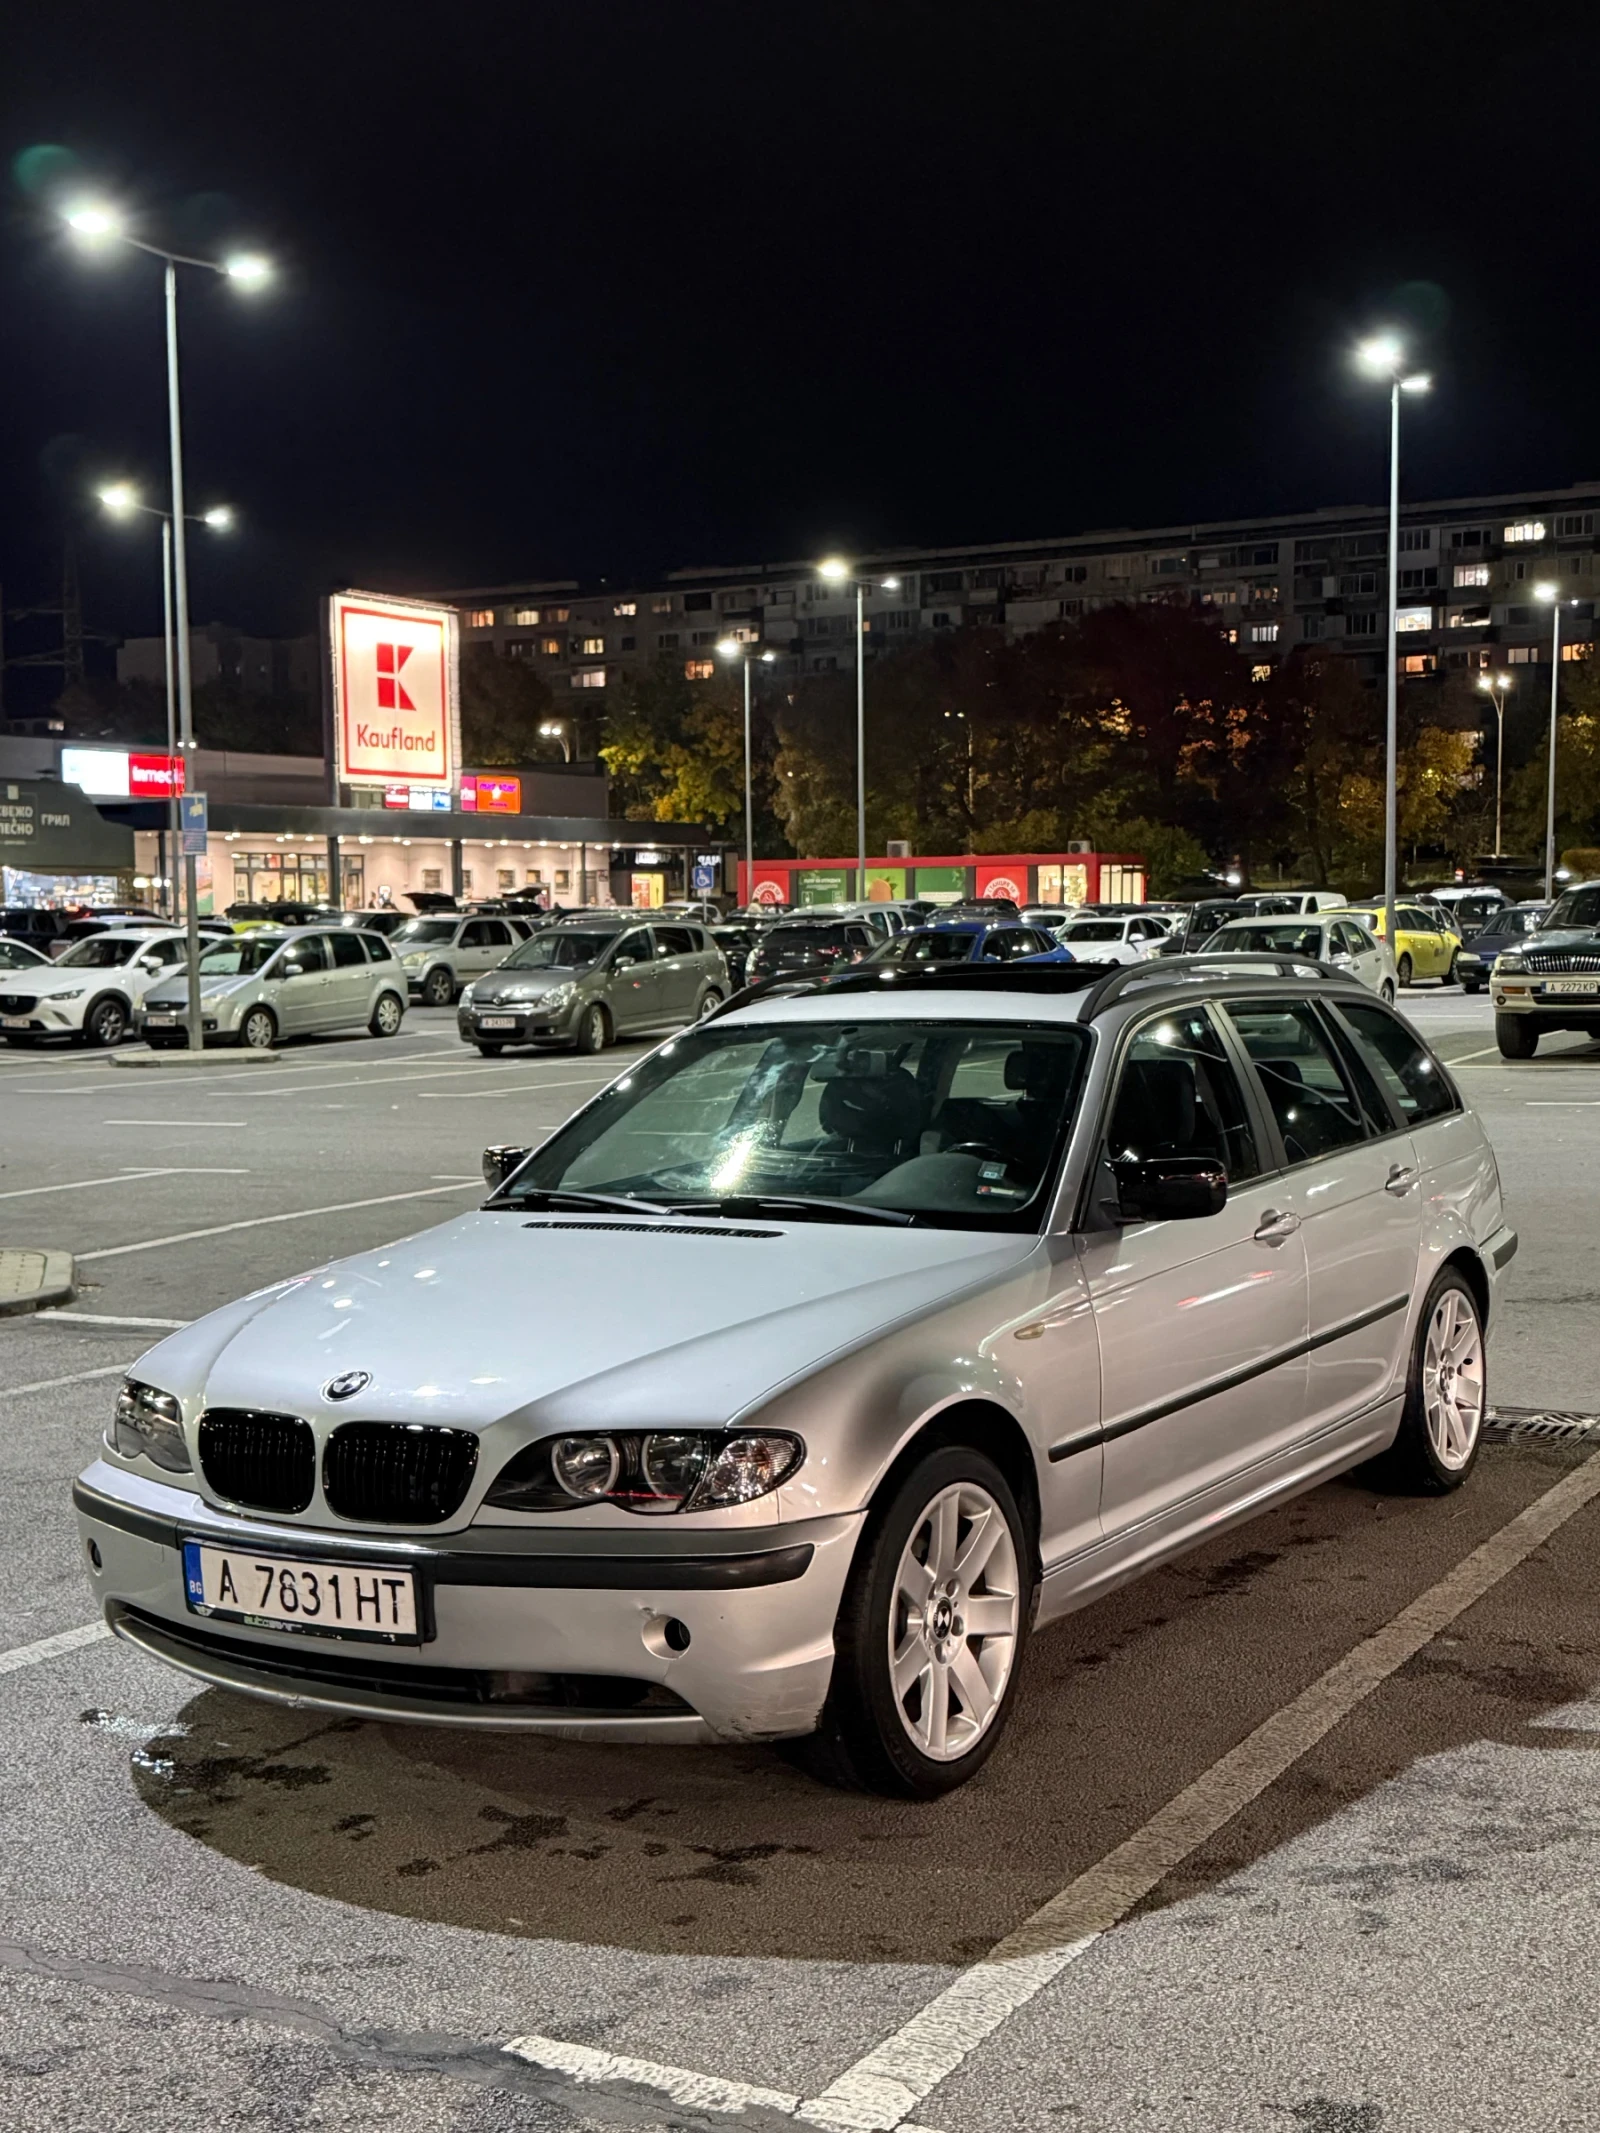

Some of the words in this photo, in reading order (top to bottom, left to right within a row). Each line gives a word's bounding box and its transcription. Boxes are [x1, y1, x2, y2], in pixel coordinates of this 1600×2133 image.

[356, 723, 436, 752] Kaufland
[41, 812, 71, 827] ГРИЛ
[1550, 983, 1556, 992] A
[189, 1580, 202, 1595] BG
[219, 1558, 239, 1604] A
[255, 1564, 342, 1619] 7831
[354, 1576, 405, 1625] HT
